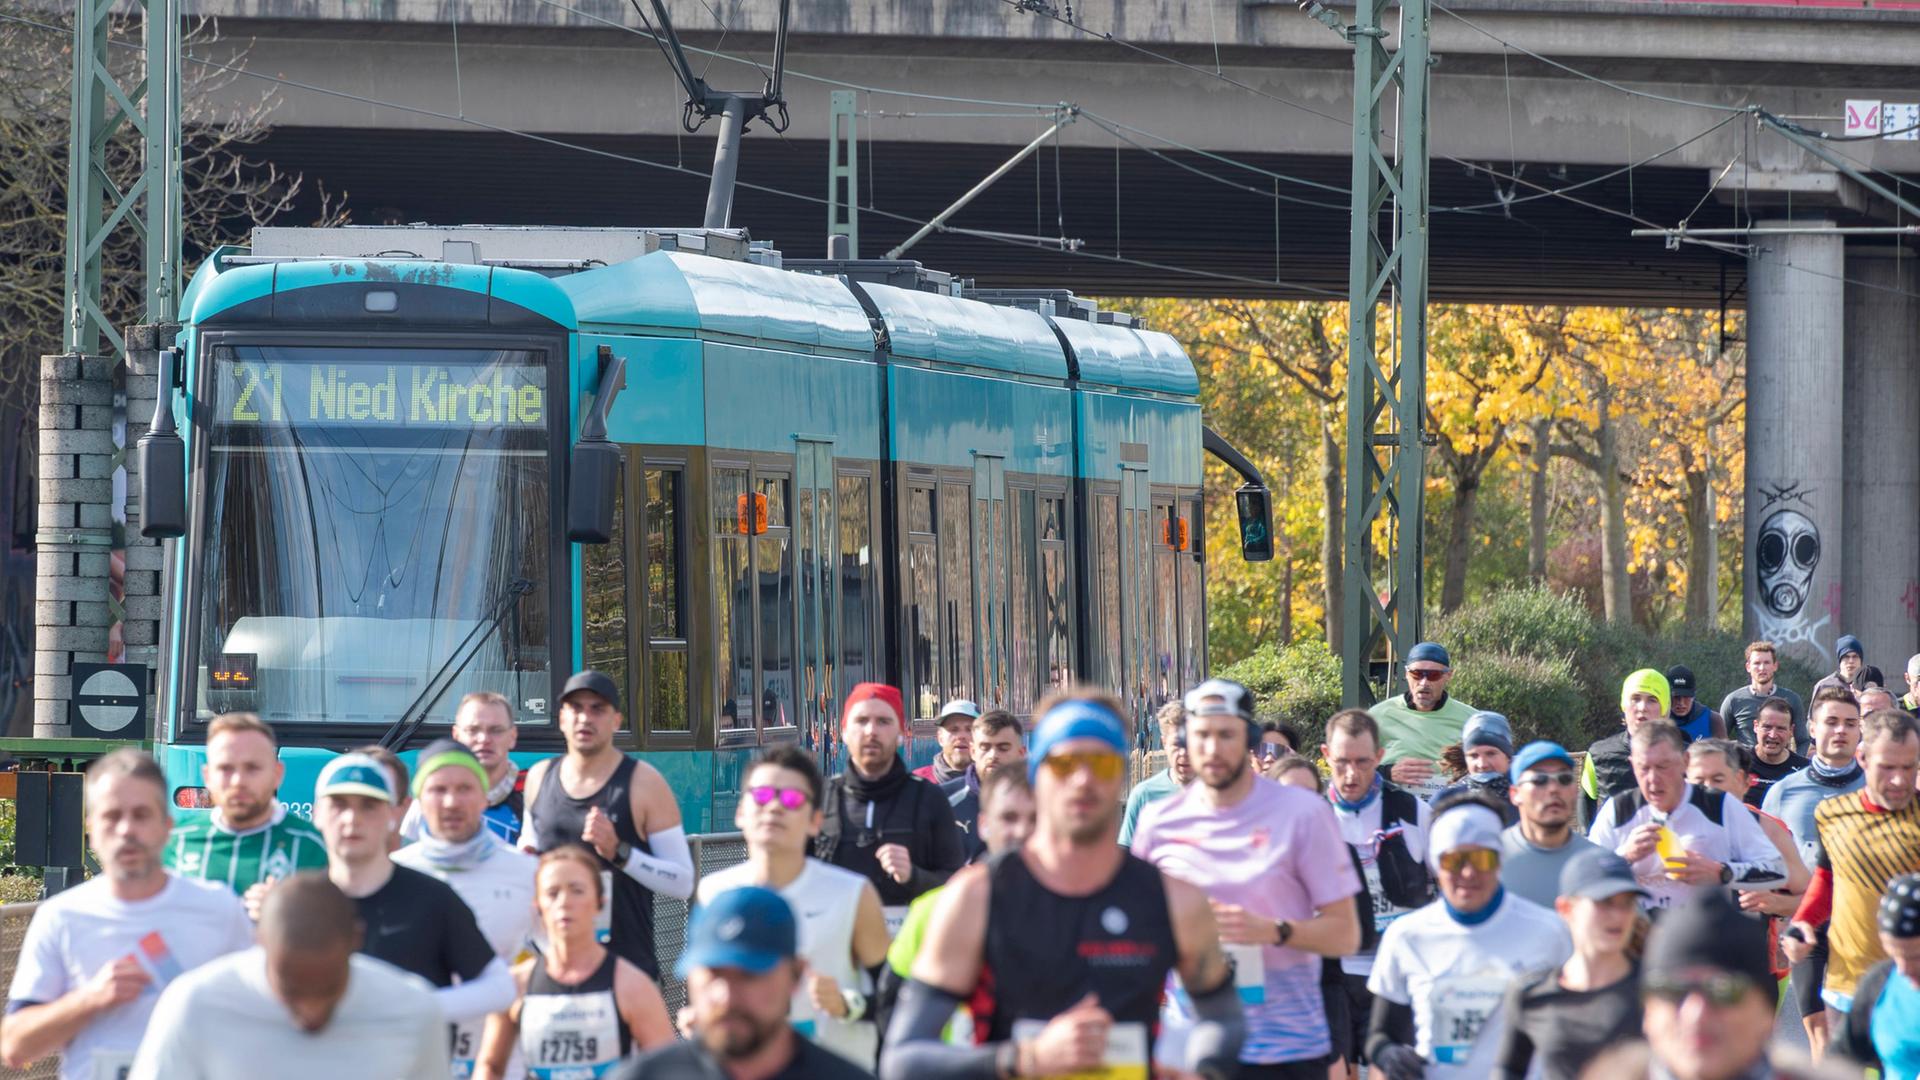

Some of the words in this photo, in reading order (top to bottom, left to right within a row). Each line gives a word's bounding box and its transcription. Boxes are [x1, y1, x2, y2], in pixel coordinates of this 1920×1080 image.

[233, 365, 282, 421] 21
[310, 365, 396, 421] Nied
[411, 366, 542, 422] Kirche
[539, 1036, 598, 1062] F2759
